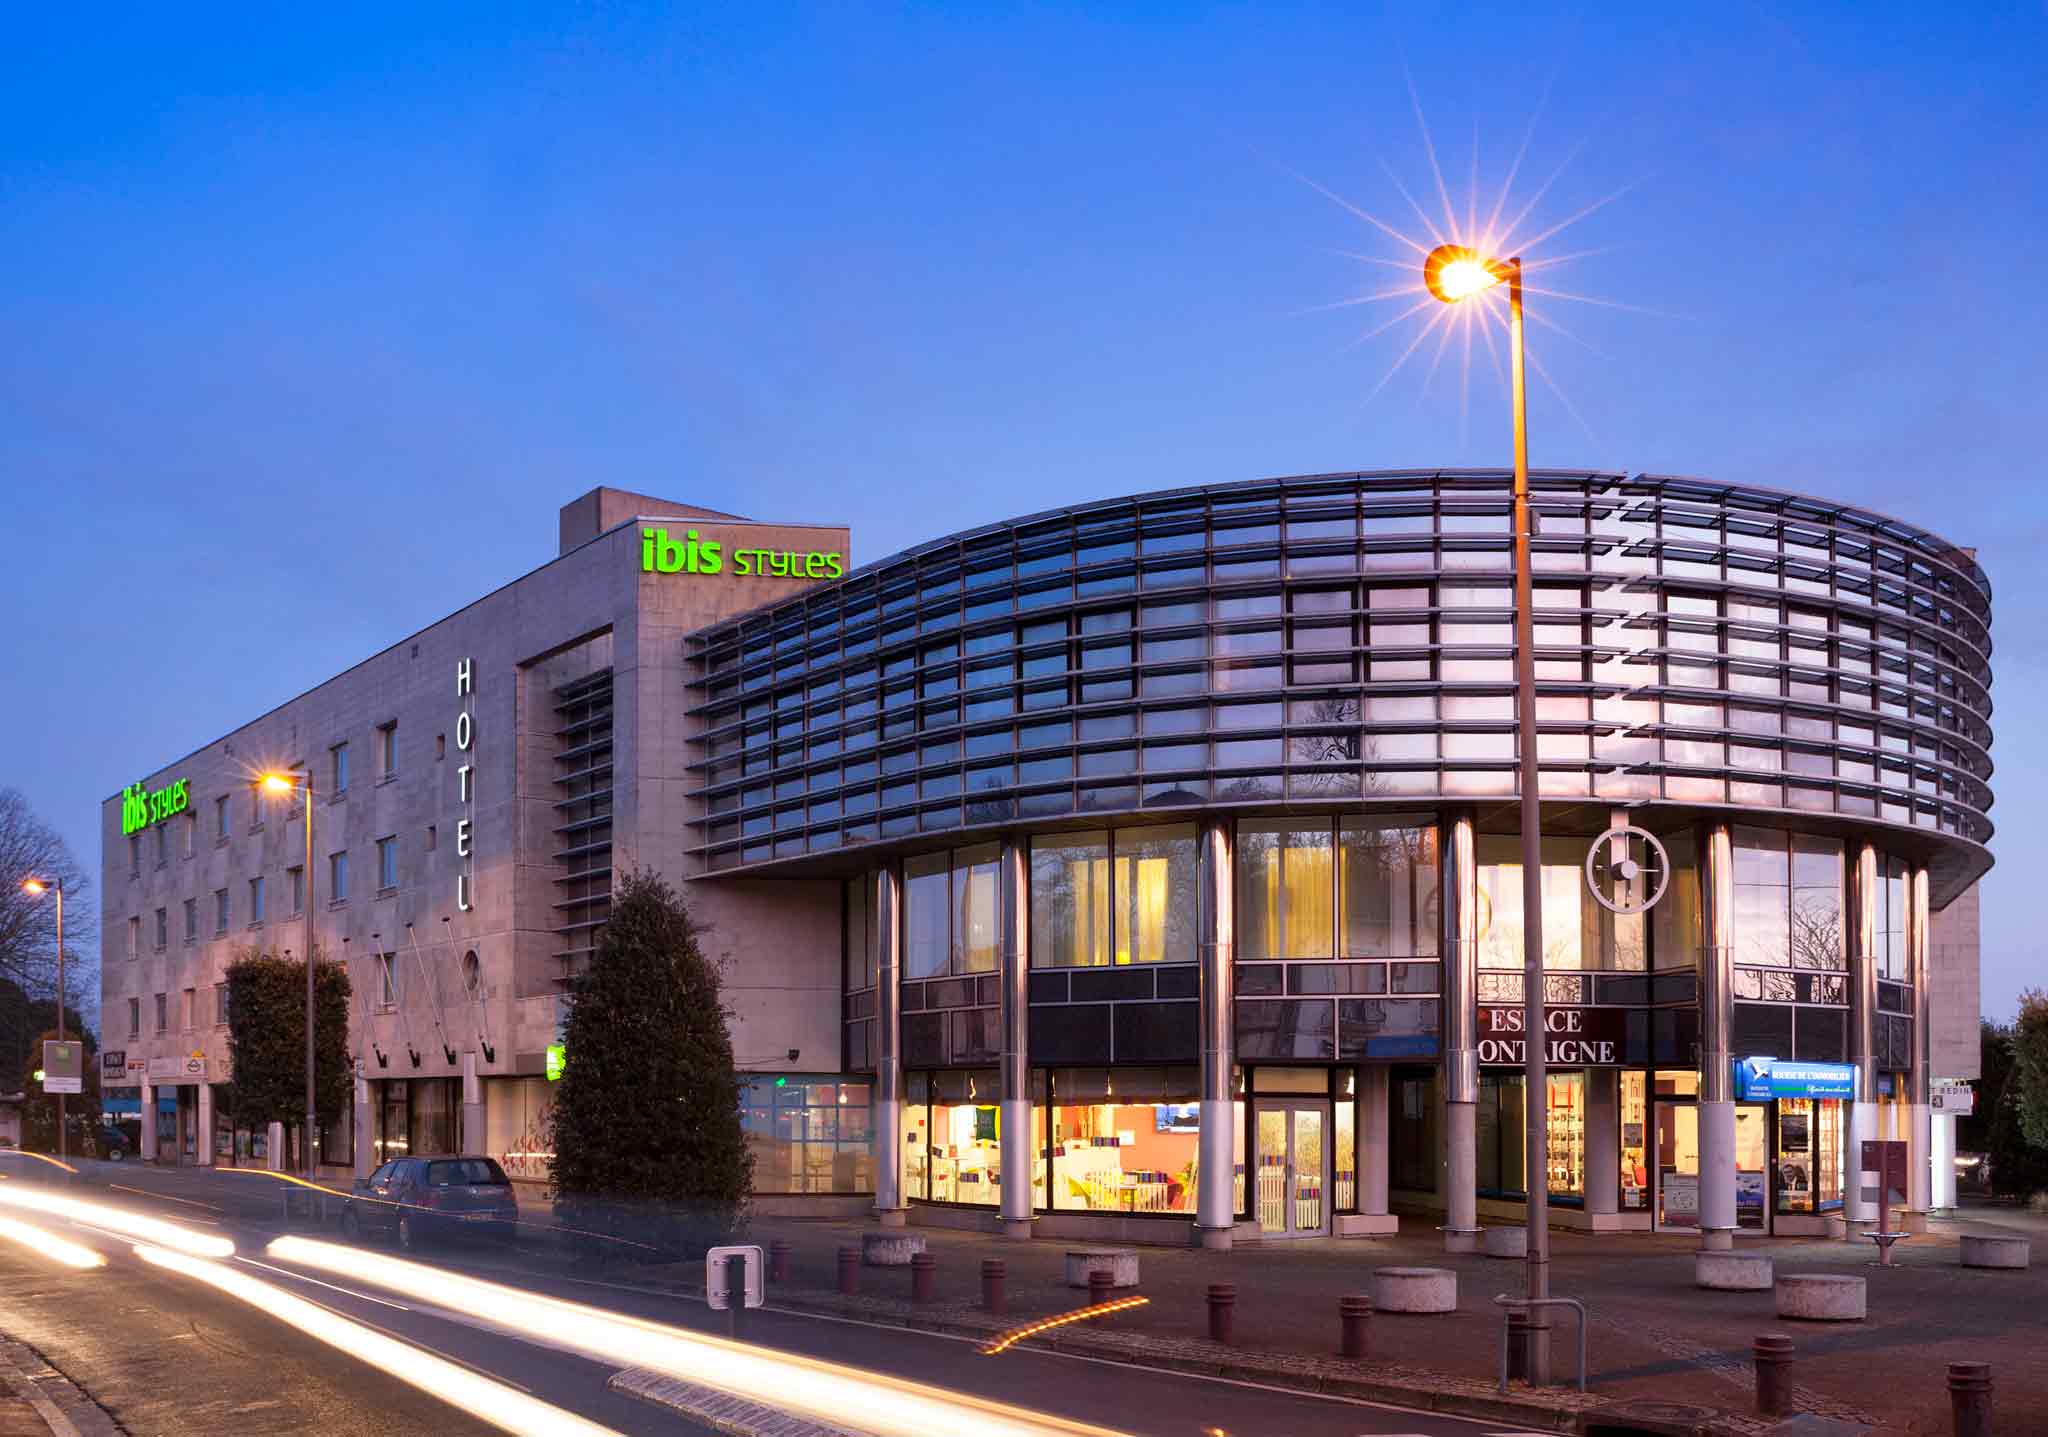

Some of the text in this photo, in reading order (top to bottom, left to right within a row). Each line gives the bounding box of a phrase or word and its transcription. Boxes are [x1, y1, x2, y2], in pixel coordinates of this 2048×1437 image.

[642, 528, 843, 578] ibis STYLES
[123, 783, 147, 835] ibis
[457, 658, 470, 911] HOTEL
[1489, 1009, 1582, 1033] ESCE
[1478, 1039, 1615, 1063] ONTIGNE
